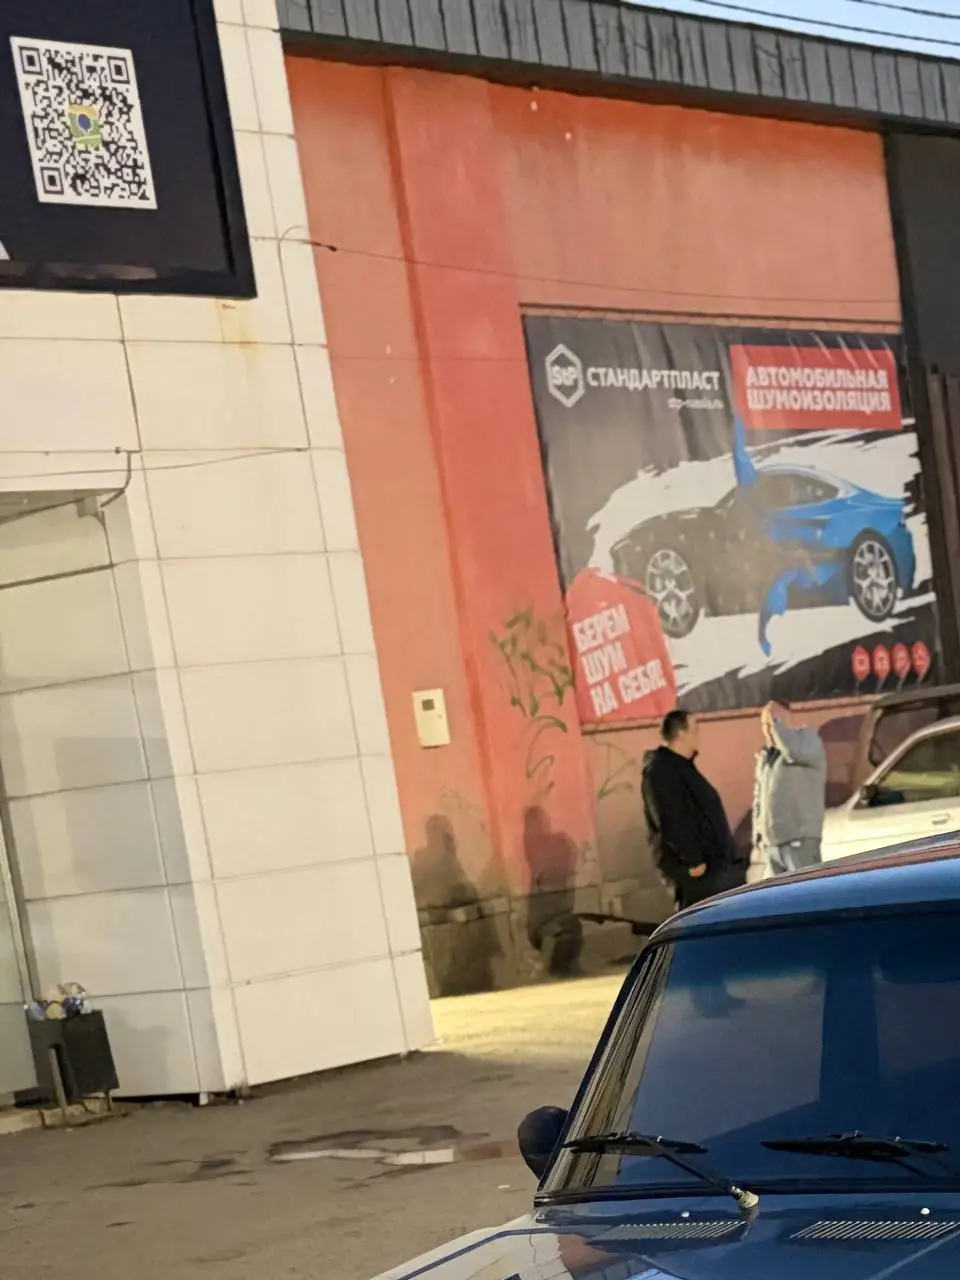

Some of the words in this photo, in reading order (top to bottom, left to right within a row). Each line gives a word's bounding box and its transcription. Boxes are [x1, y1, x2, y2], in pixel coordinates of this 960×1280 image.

[586, 367, 721, 391] СТАНДАРТПЛАСТ
[746, 366, 889, 389] АВТОМОБИЛЬНАЯ
[747, 388, 893, 415] ШУМОИЗОЛЯЦИЯ
[581, 641, 628, 685] ШУМ
[589, 681, 619, 718] НА
